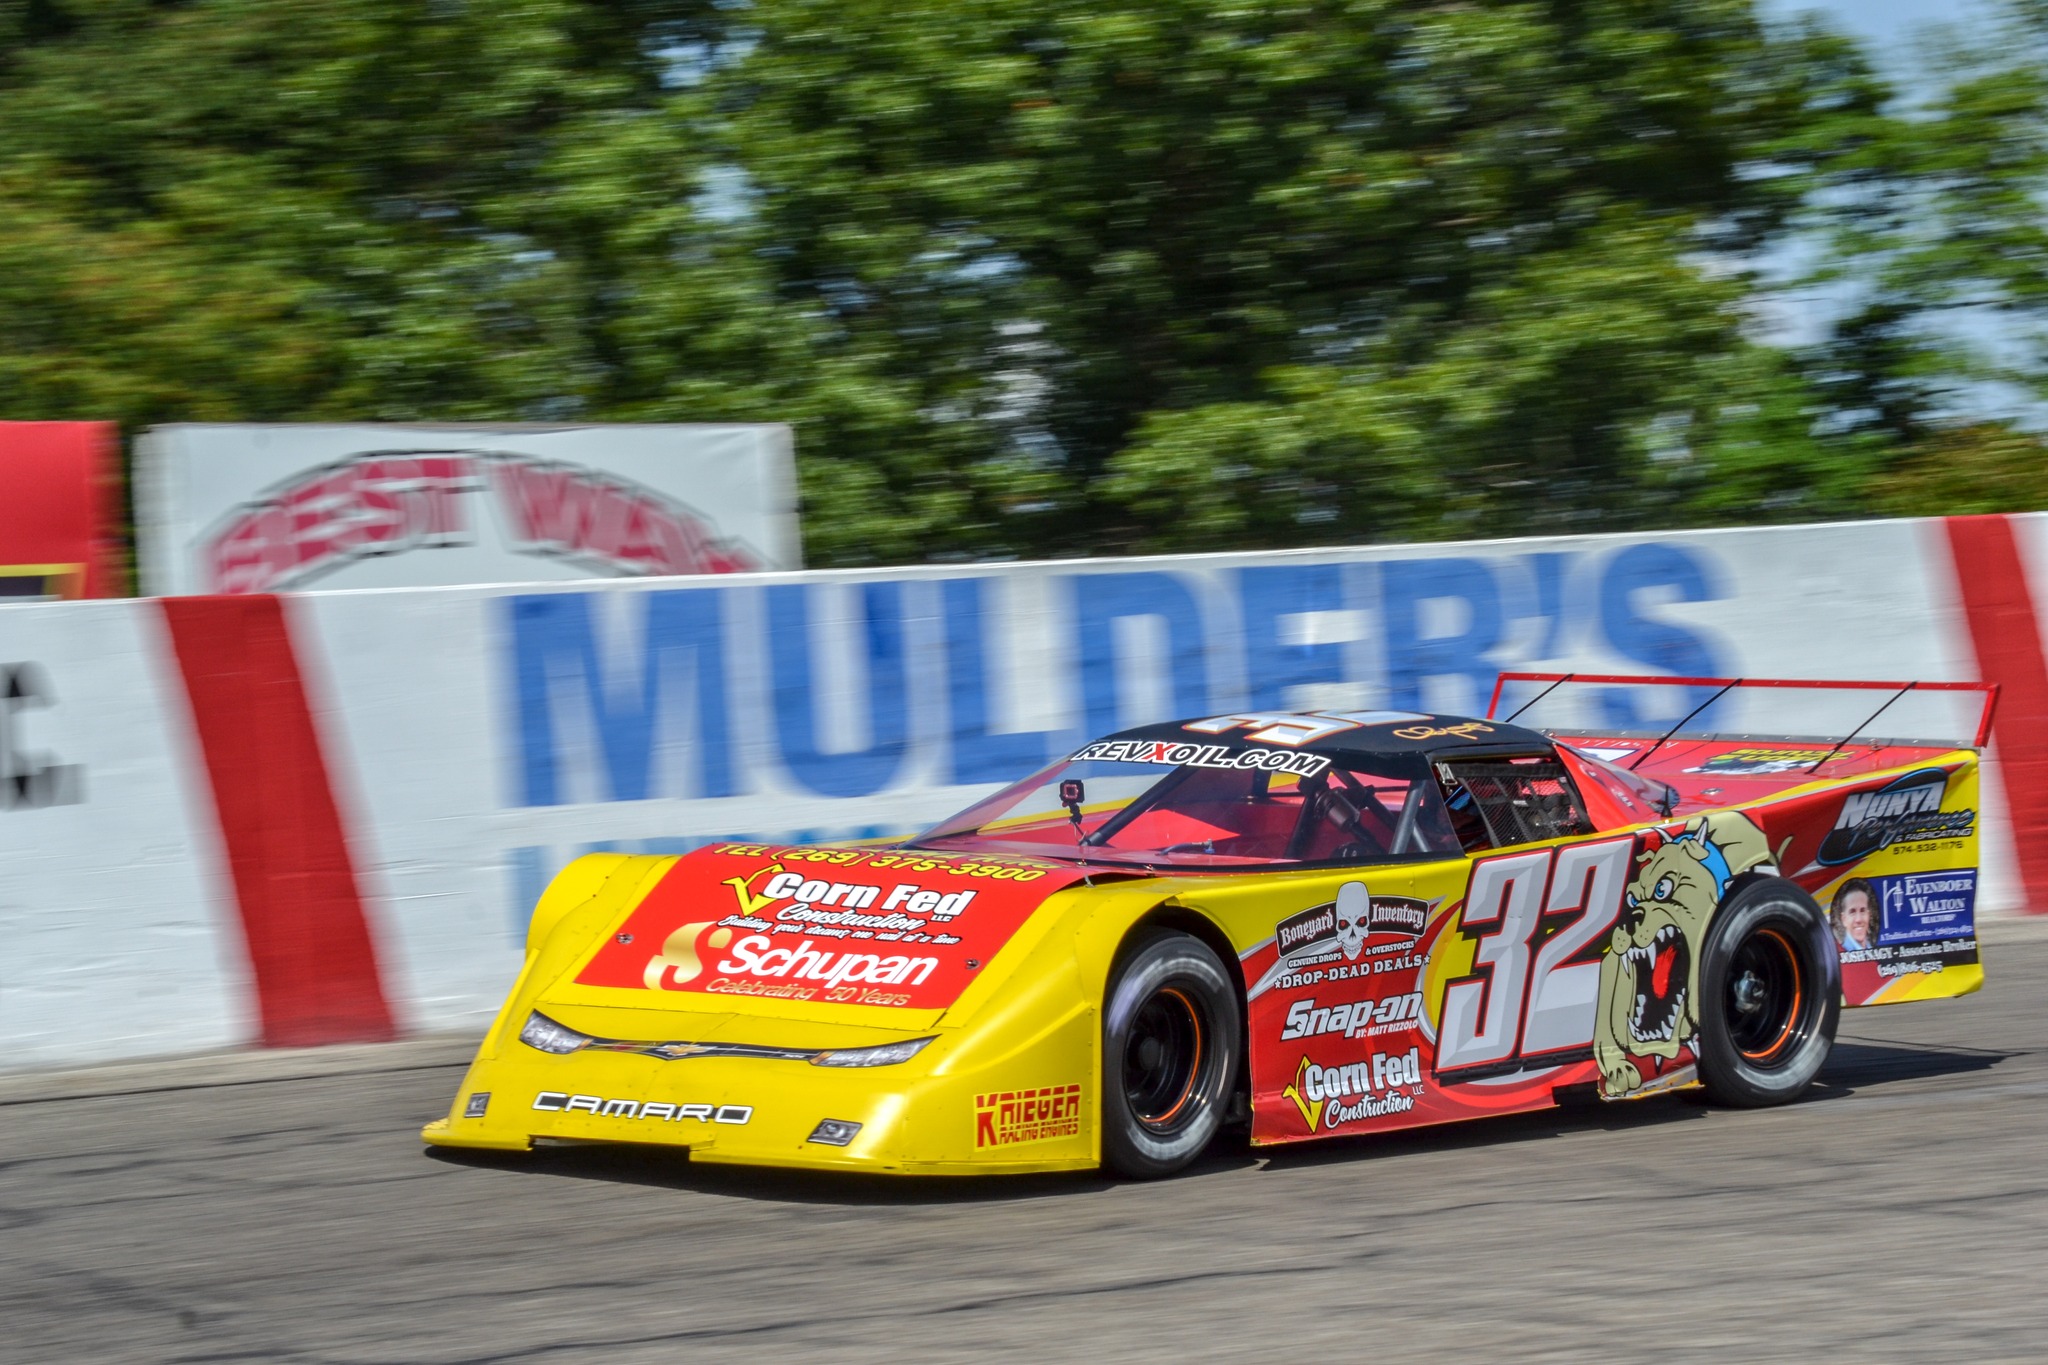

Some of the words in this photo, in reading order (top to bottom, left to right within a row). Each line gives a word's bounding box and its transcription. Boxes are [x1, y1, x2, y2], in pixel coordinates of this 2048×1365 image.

[500, 540, 1734, 806] MULDER'S
[1072, 741, 1331, 777] REVXOIL.COM
[1833, 780, 1947, 831] NUNYA
[1905, 827, 1974, 842] FABRICATING
[712, 844, 770, 858] TEL
[770, 847, 874, 867] (269)
[869, 855, 1049, 882] 375-3900
[762, 872, 880, 909] Corn
[881, 883, 980, 917] Fed
[1909, 896, 1966, 914] WALTON
[776, 902, 928, 932] Construction
[1281, 908, 1334, 948] Boneyard
[1371, 903, 1425, 930] Inventory
[717, 935, 939, 988] Schupan
[1282, 963, 1371, 989] DROP-DEAD
[1373, 955, 1423, 974] DEALS
[1288, 954, 1318, 968] GENUINE
[1318, 952, 1342, 964] DROPS
[1365, 946, 1373, 956] &
[1372, 940, 1415, 955] OVERSTOCKS
[1435, 834, 1635, 1074] 32
[705, 977, 818, 1001] Celebrating
[825, 986, 854, 1000] 50
[855, 989, 912, 1006] Years
[1281, 991, 1424, 1041] Snap-on
[1355, 1028, 1367, 1039] BY:
[1367, 1025, 1388, 1037] MATT
[1388, 1020, 1419, 1034] RIZZOLO
[1304, 1061, 1371, 1102] Corn
[1371, 1047, 1422, 1091] Fed
[1412, 1085, 1425, 1096] LLC
[532, 1090, 754, 1125] CAMARO
[976, 1084, 1080, 1148] KRIEGER
[1324, 1090, 1414, 1129] Construction
[999, 1122, 1039, 1144] RACING
[1040, 1117, 1079, 1139] ENGINES
